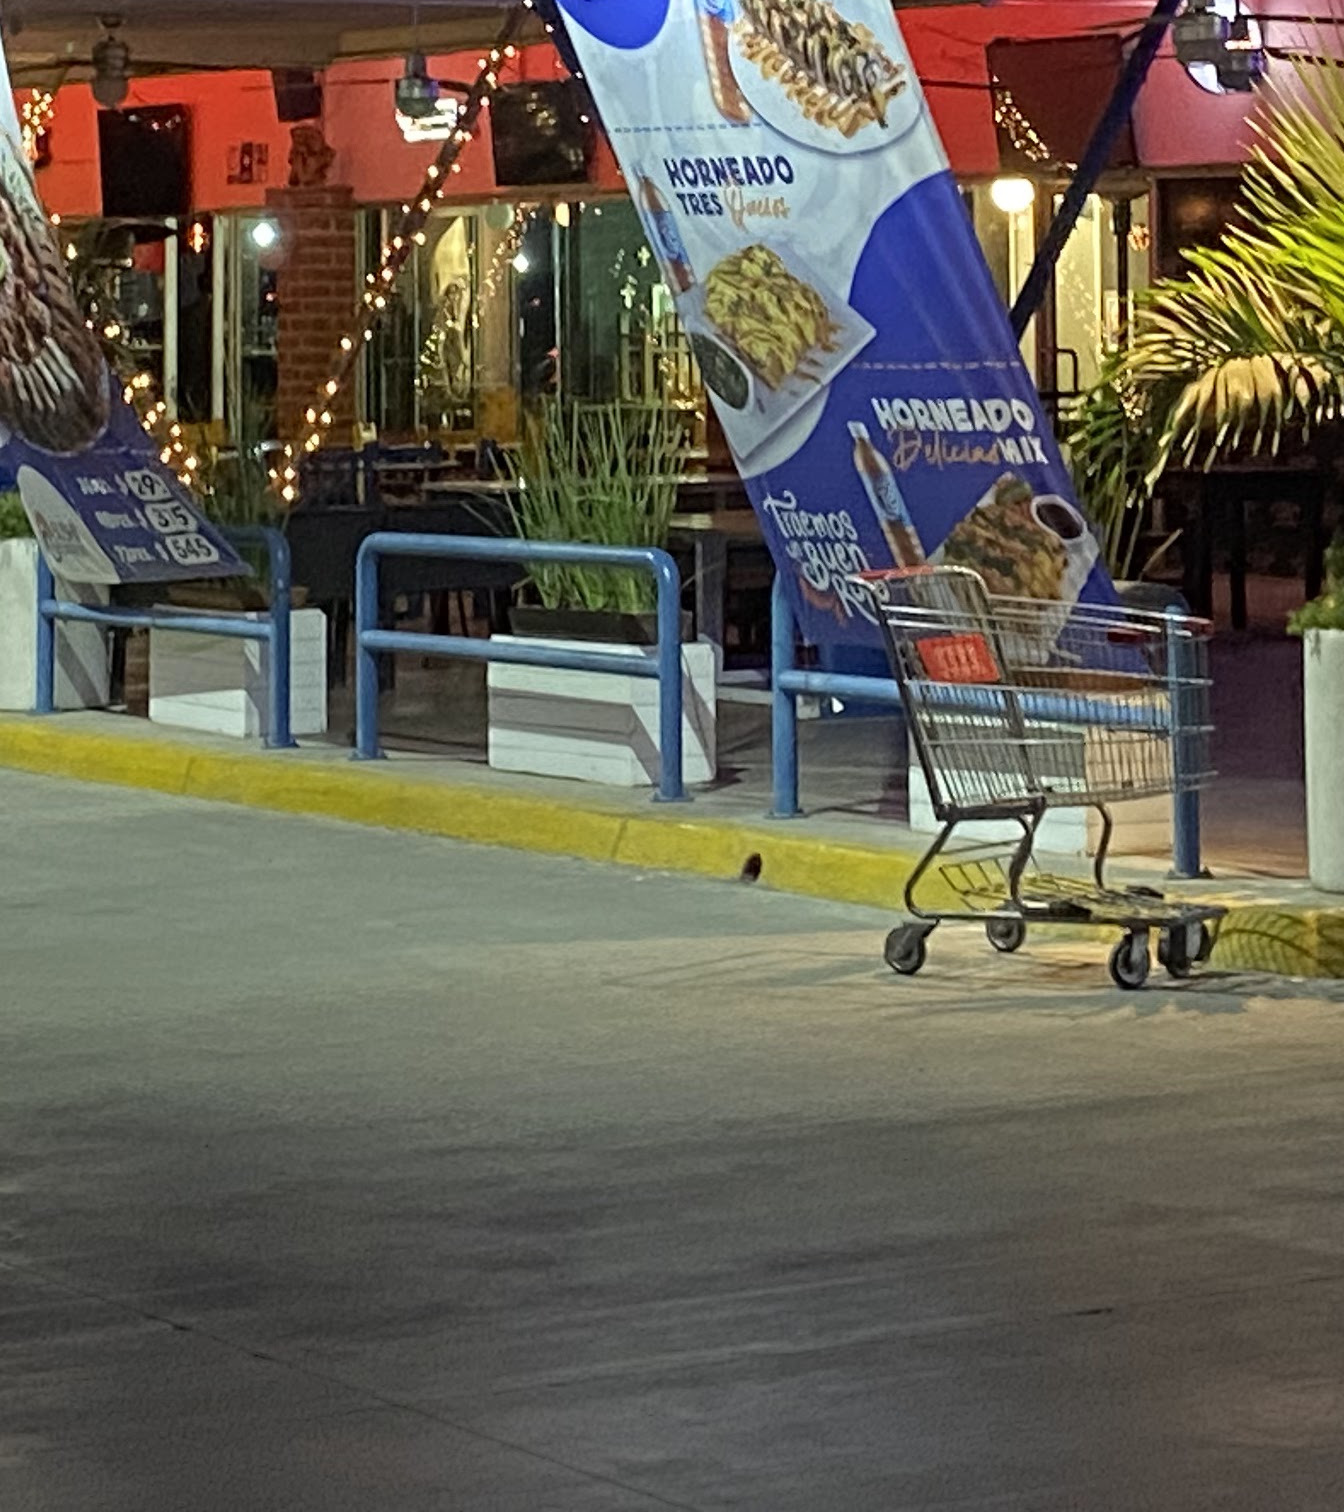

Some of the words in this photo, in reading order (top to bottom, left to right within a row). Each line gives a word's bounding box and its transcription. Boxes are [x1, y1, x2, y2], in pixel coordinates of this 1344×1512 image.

[663, 154, 795, 188] HORNEADO
[676, 190, 724, 217] TRES
[870, 397, 1035, 433] HORNEADO
[997, 434, 1049, 466] MIX
[762, 489, 859, 542] Traemos
[801, 540, 872, 592] Buen
